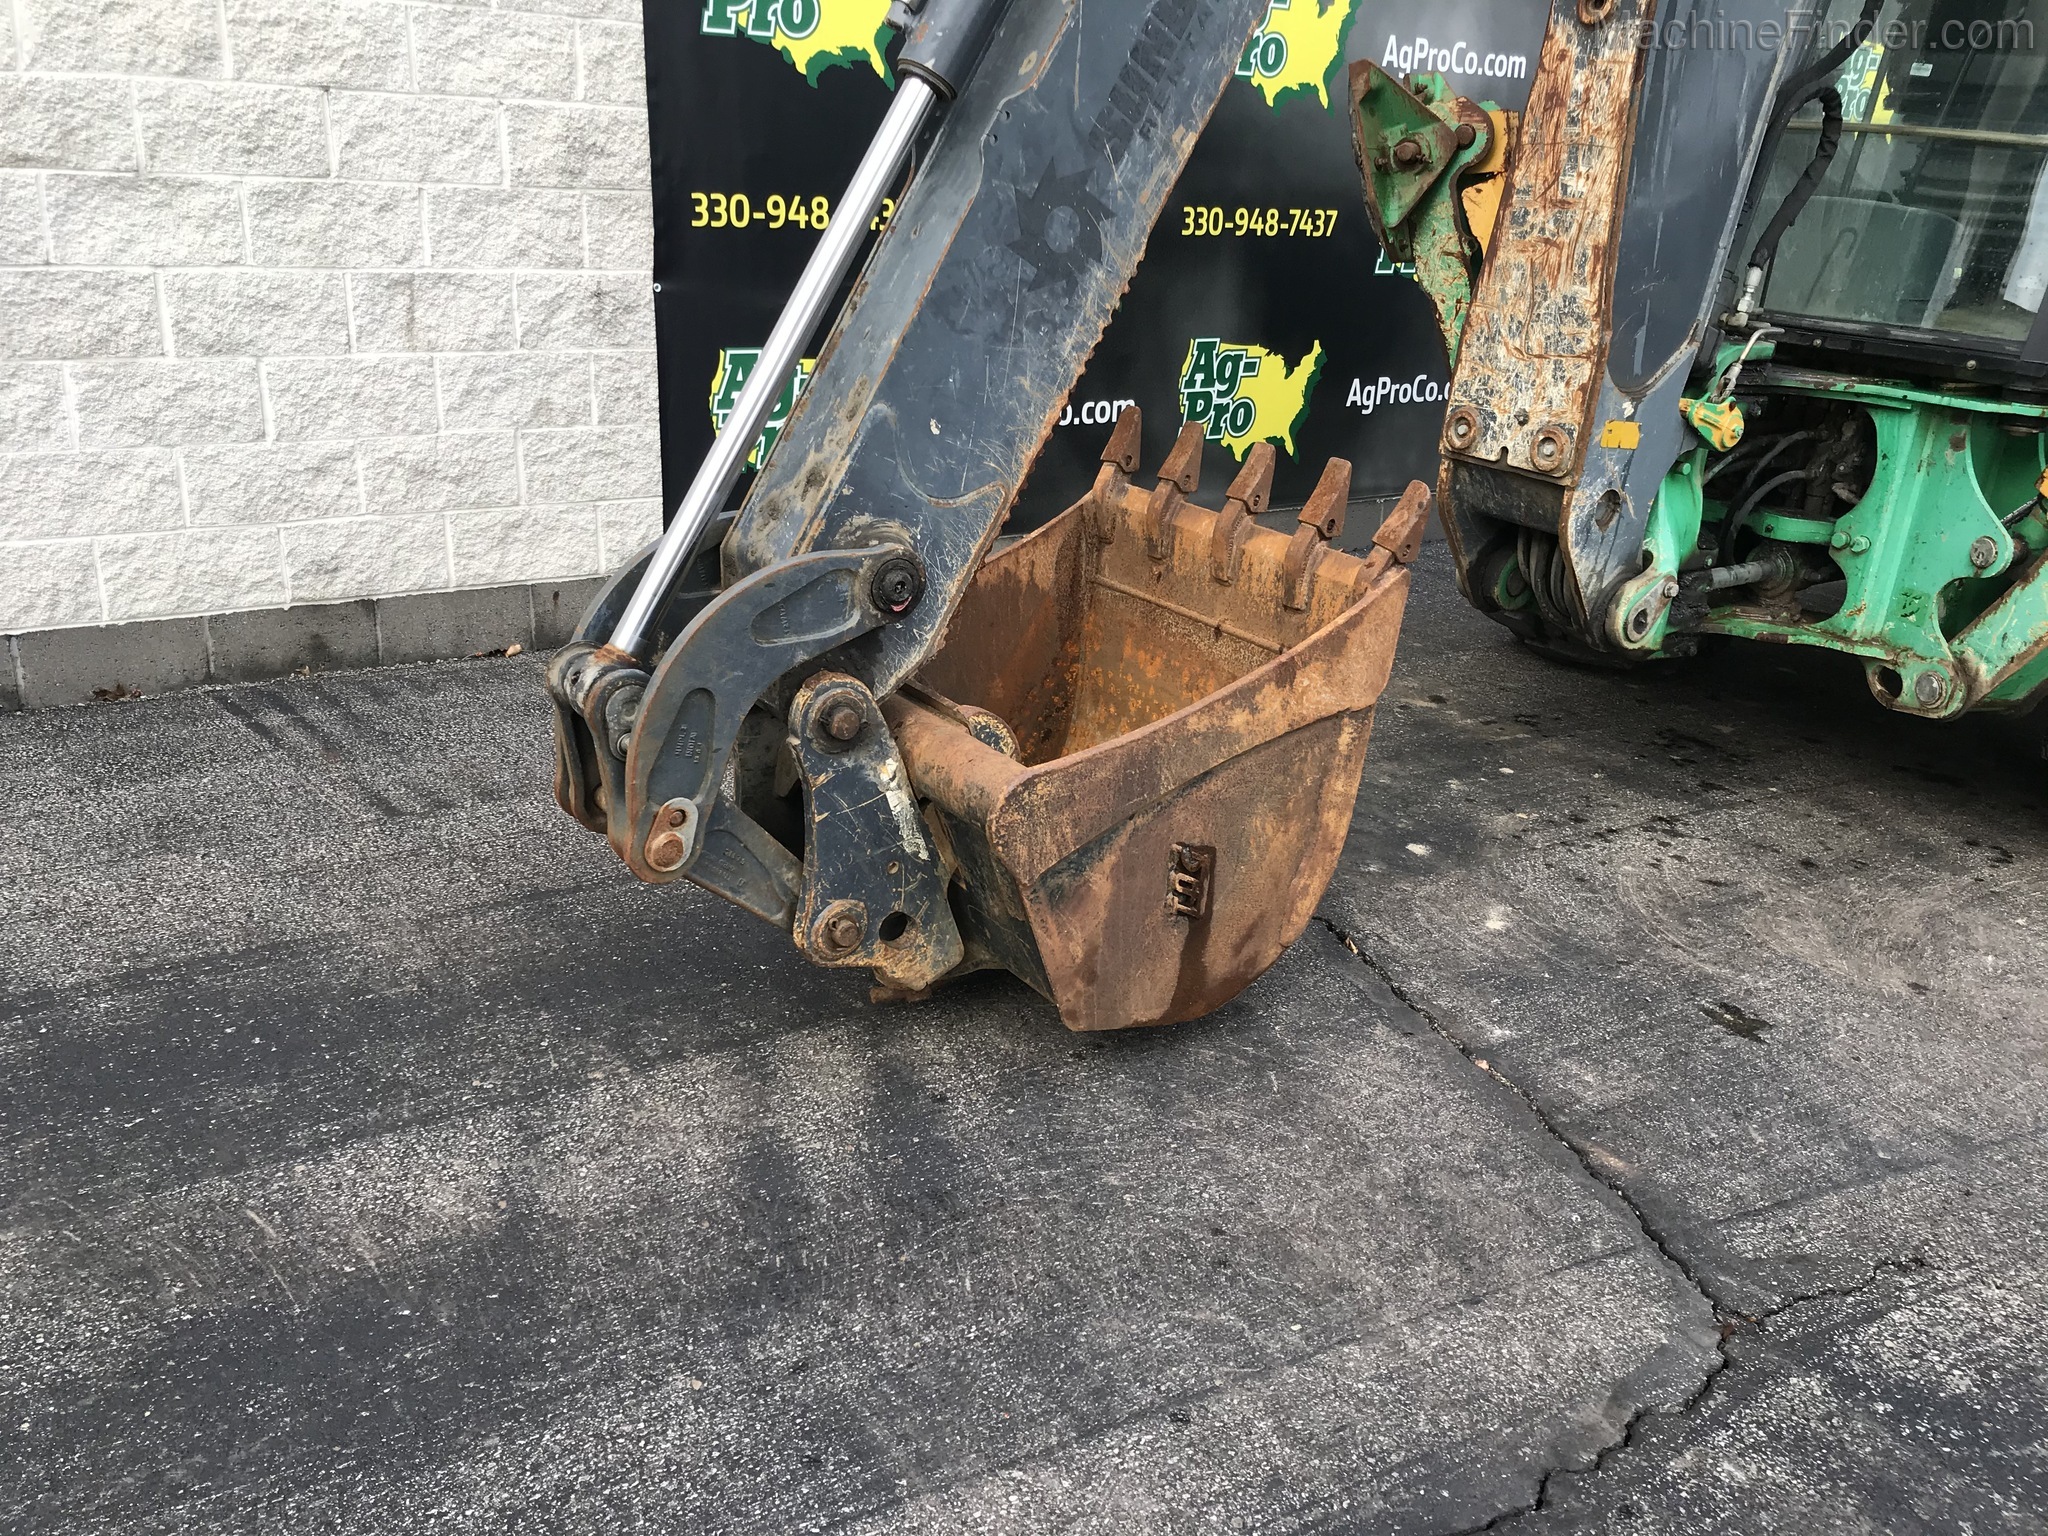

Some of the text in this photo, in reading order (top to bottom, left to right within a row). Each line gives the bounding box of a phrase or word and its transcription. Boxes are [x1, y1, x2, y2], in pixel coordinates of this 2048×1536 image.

[1235, 31, 1287, 77] ro
[1381, 34, 1527, 79] AgProCo.com
[1181, 206, 1339, 238] 330-948-7437
[1181, 338, 1261, 401] Ag-
[1178, 391, 1256, 439] Pro
